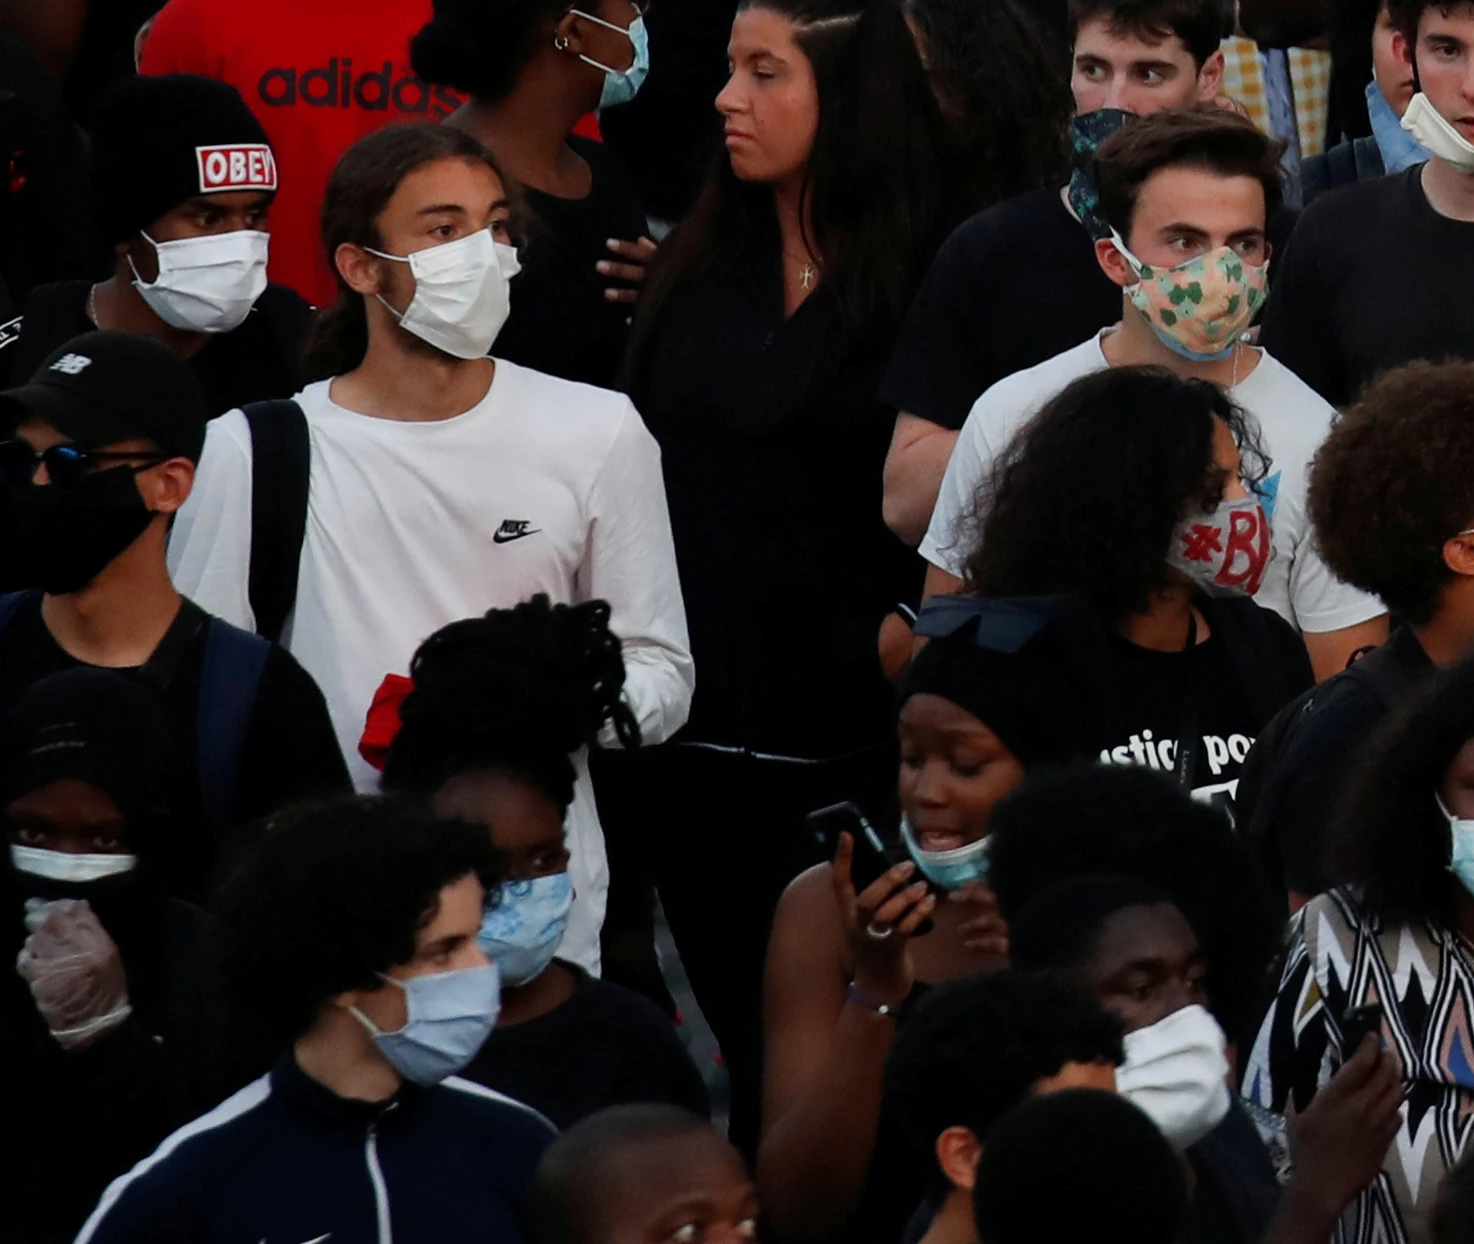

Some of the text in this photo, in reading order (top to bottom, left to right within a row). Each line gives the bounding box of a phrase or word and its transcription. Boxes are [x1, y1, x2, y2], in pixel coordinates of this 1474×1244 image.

[258, 56, 472, 123] adidas
[204, 148, 276, 186] OBEY
[500, 519, 529, 536] NIKE
[1098, 728, 1179, 772] stic
[1201, 732, 1257, 776] po
